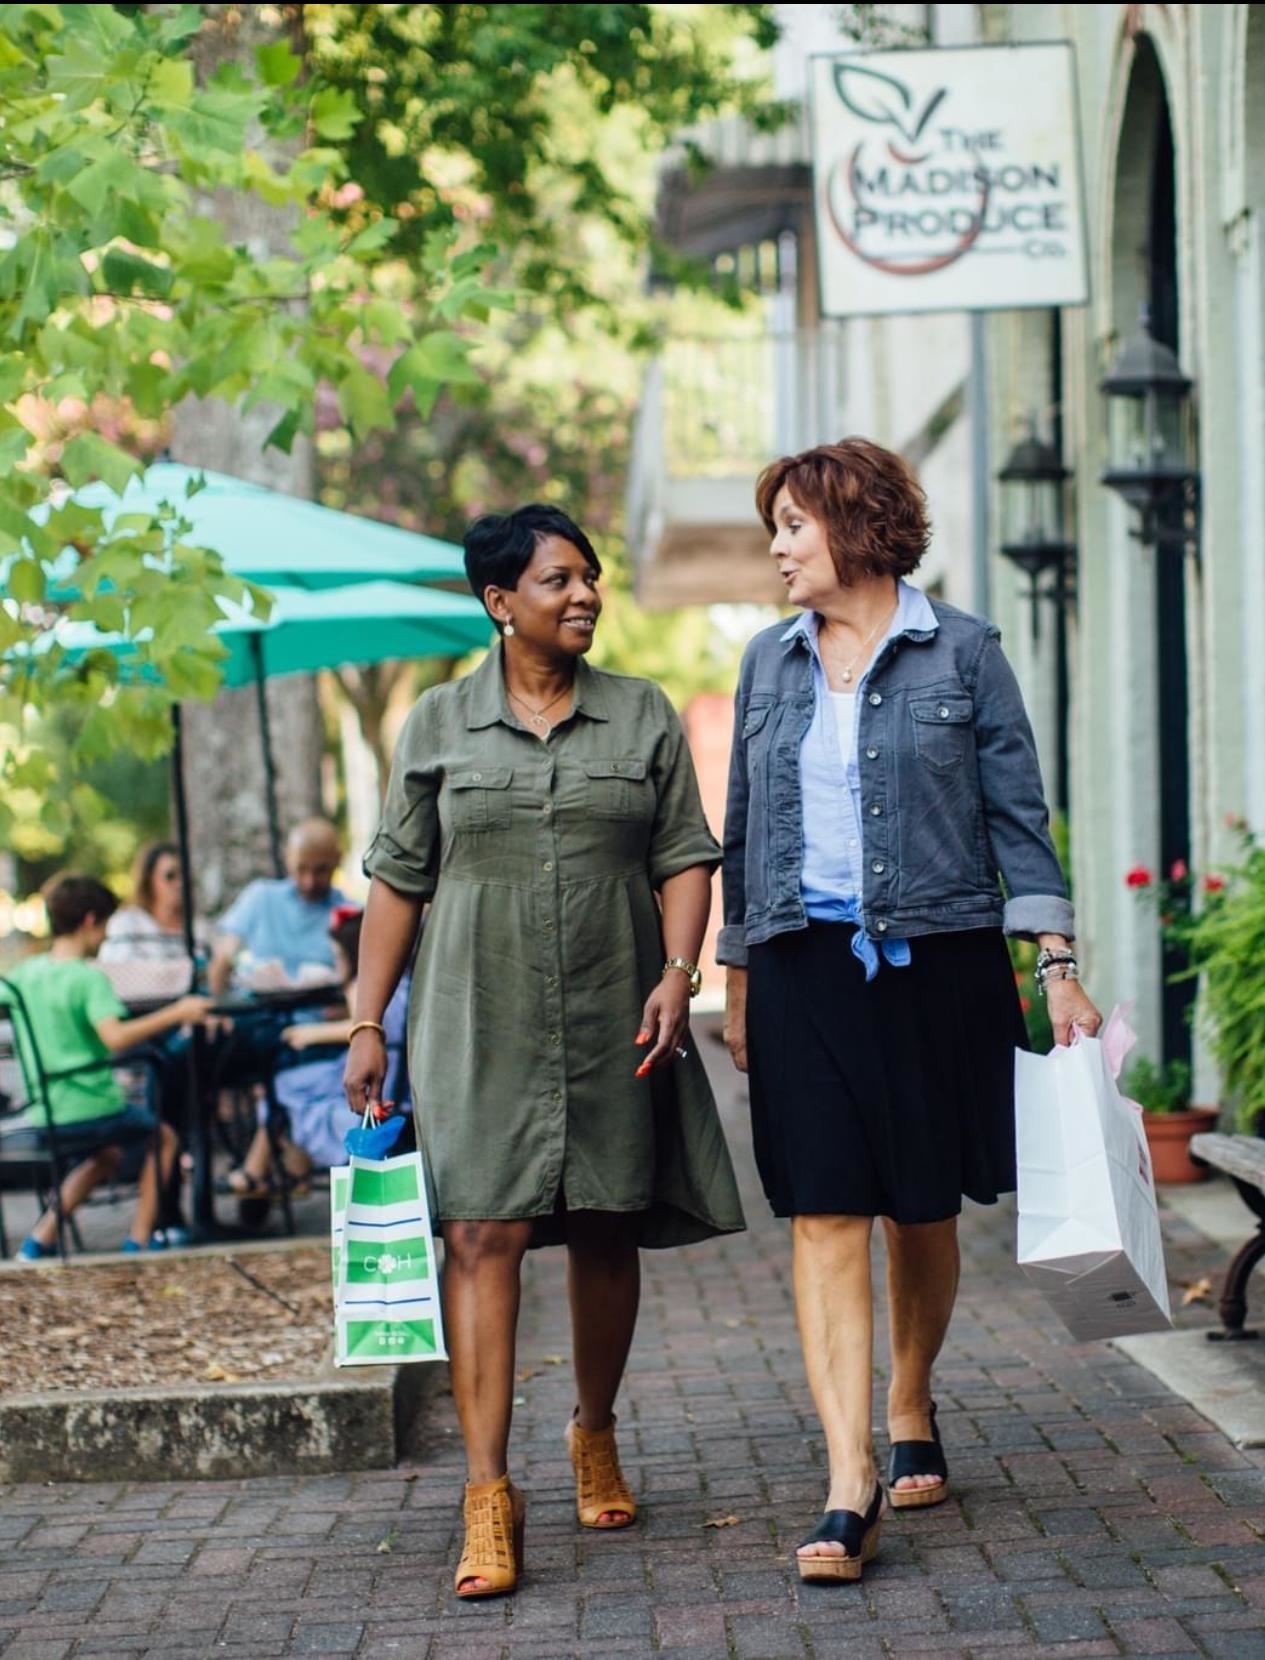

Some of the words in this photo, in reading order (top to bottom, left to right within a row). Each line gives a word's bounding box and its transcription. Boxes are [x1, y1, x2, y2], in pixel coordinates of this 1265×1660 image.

[940, 127, 1003, 150] THE
[853, 164, 1060, 197] MADISON
[853, 203, 1067, 241] PRODUCE
